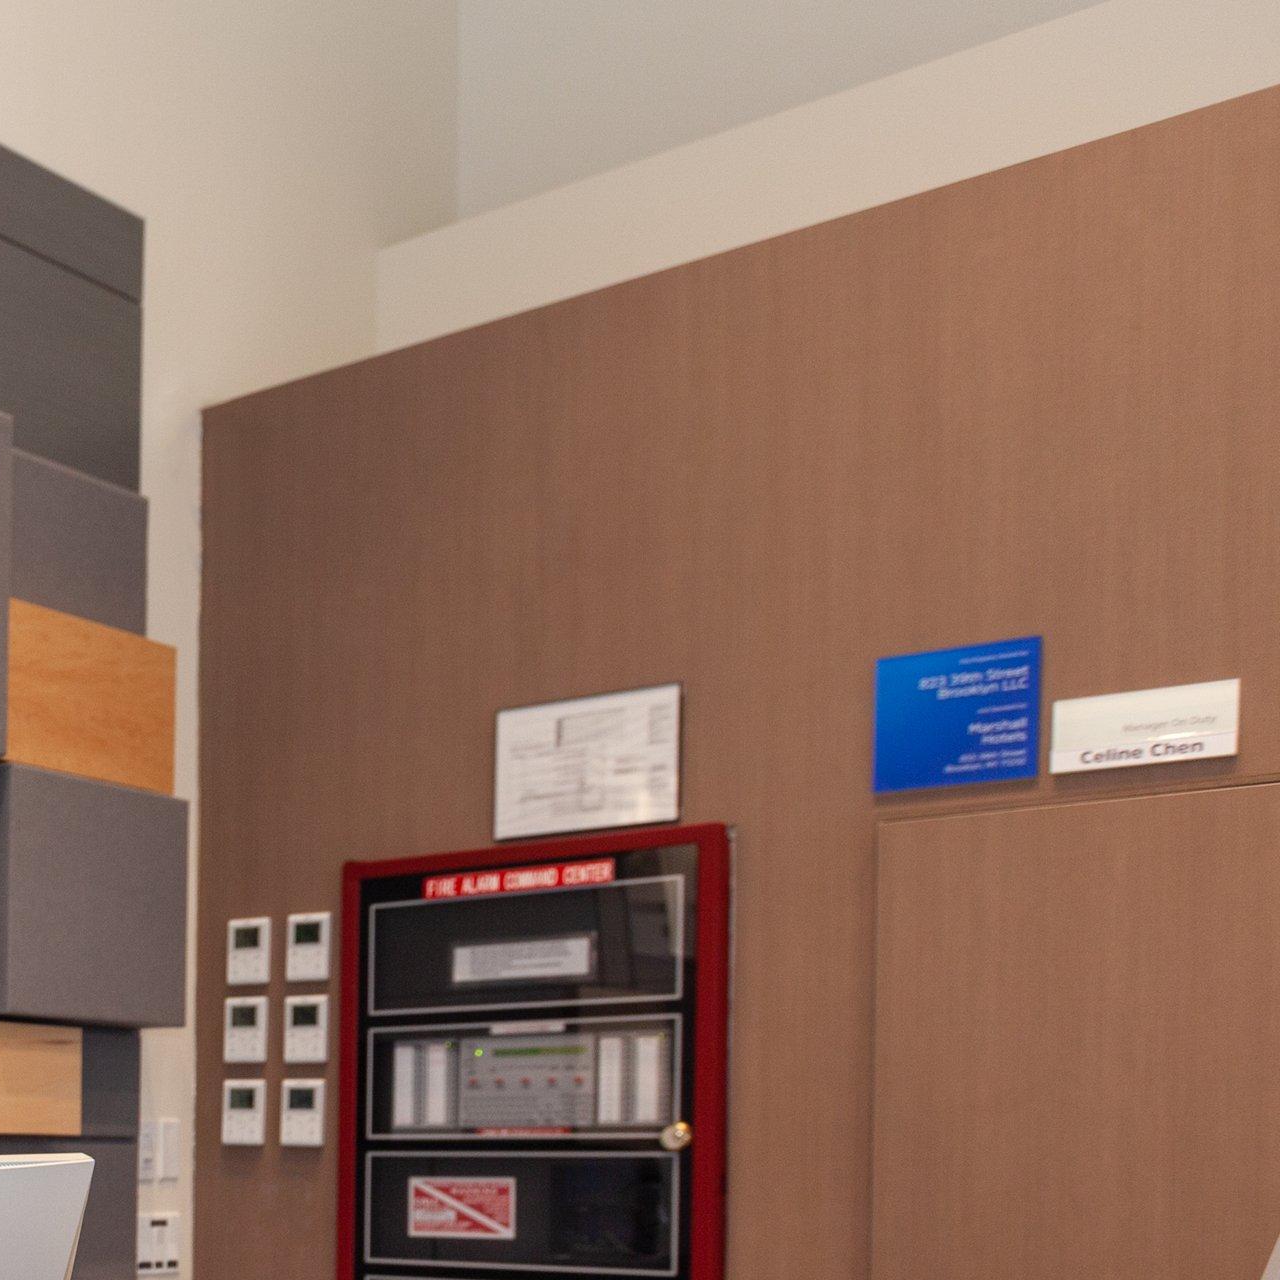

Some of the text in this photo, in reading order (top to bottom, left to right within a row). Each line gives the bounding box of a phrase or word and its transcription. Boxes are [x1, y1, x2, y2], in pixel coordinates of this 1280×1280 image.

[1080, 740, 1204, 764] Celine Chen
[425, 859, 614, 899] FIRE ALARM COMMAND CENTER
